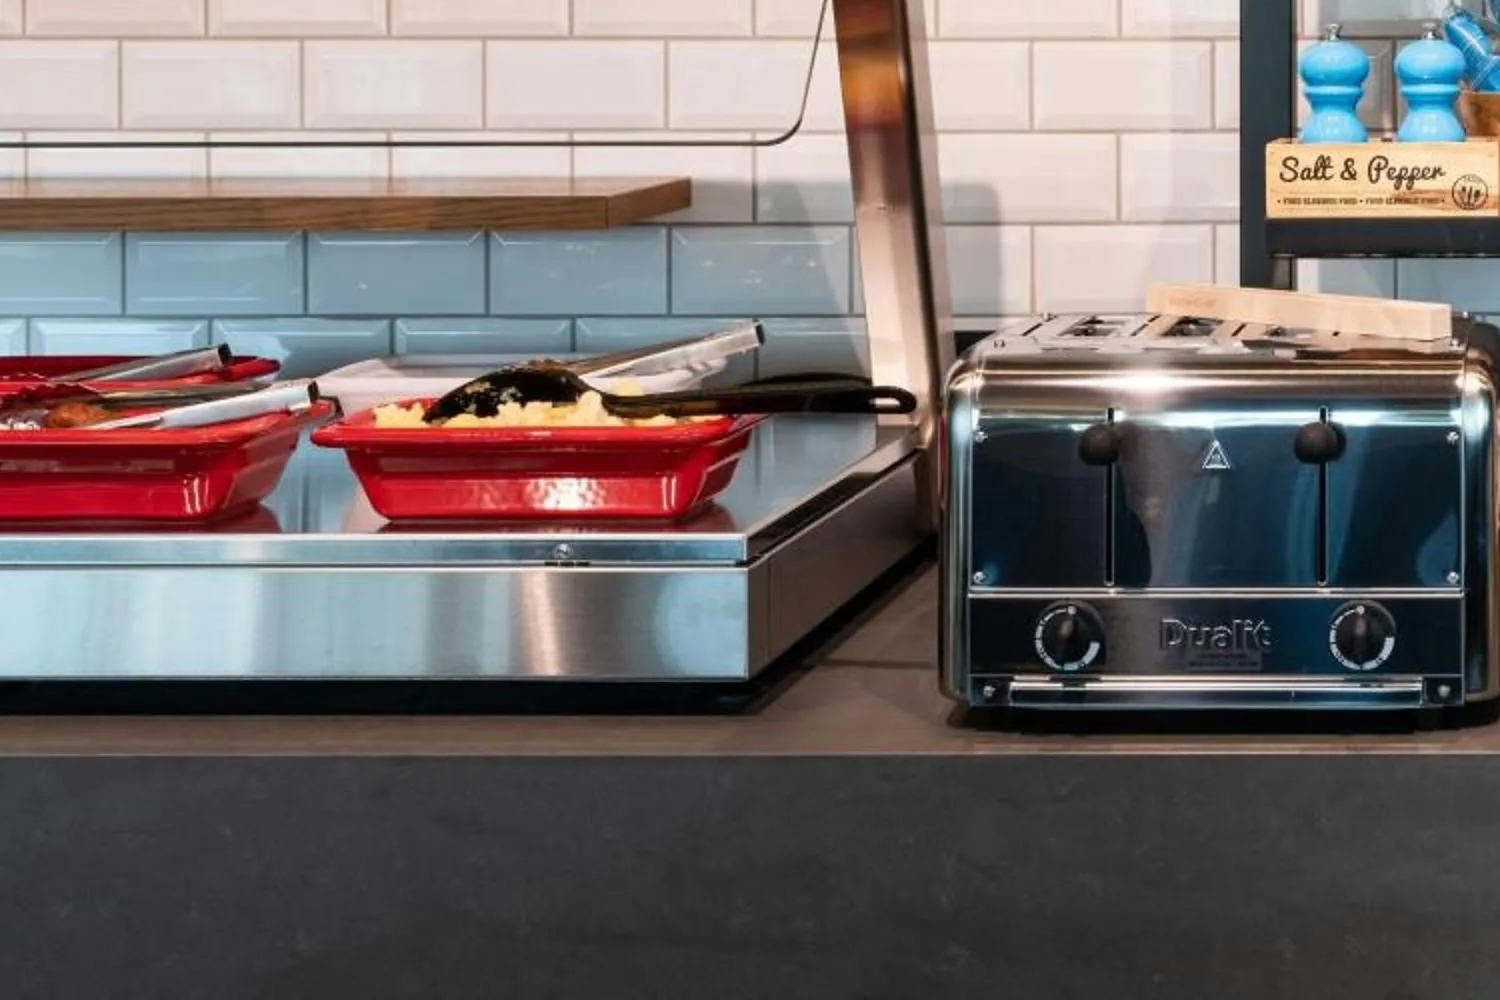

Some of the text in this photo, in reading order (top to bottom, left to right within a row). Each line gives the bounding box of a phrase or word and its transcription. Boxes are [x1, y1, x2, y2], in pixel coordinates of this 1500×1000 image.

[1279, 154, 1448, 190] Salt & Pepper
[1160, 618, 1272, 652] Dualit
